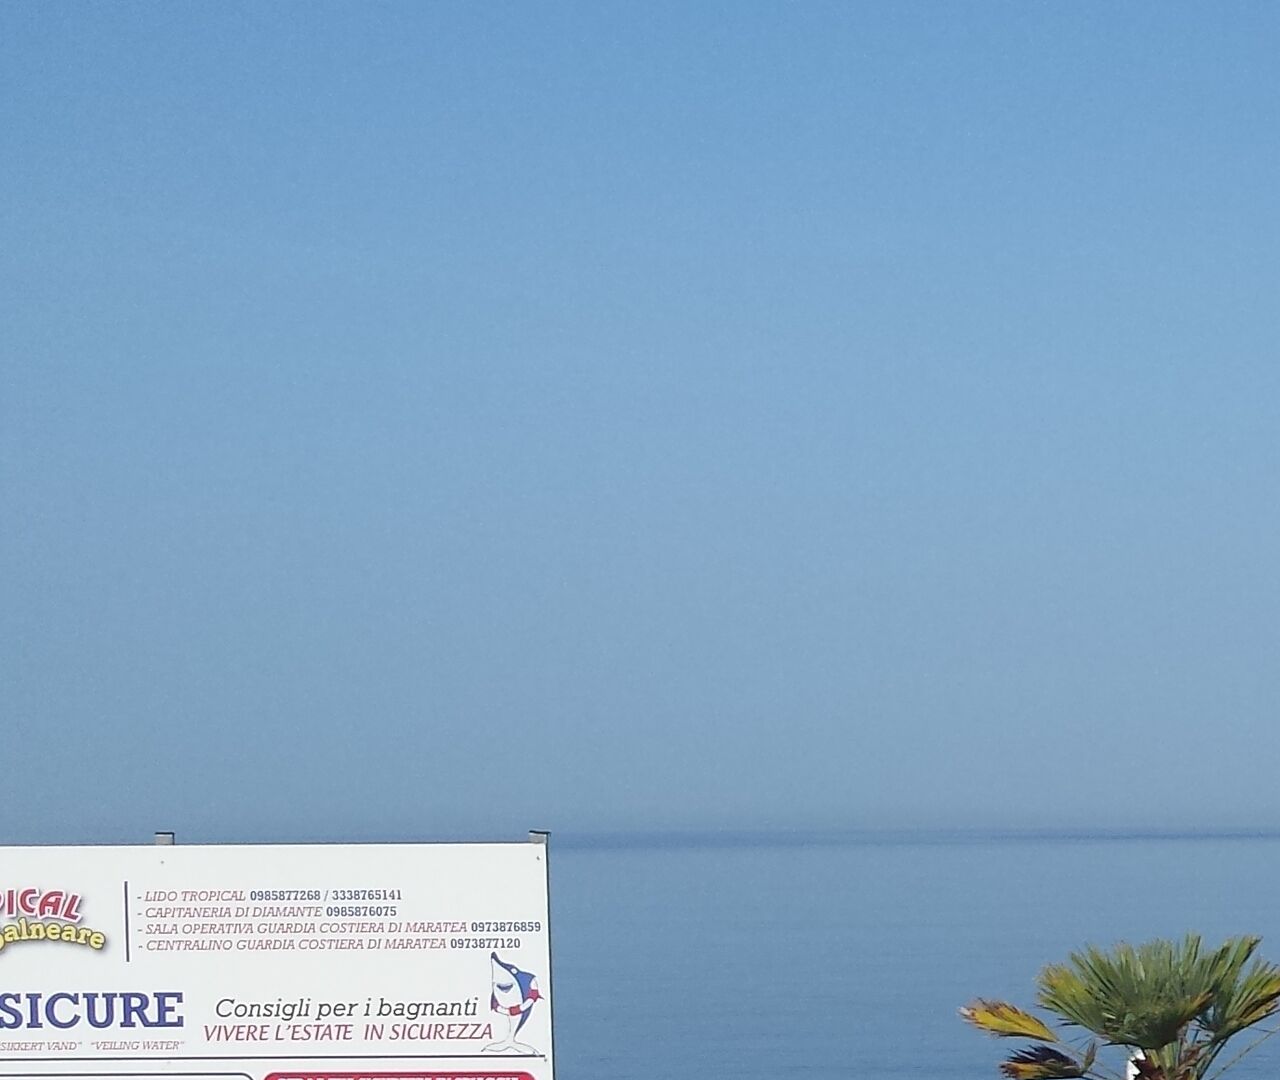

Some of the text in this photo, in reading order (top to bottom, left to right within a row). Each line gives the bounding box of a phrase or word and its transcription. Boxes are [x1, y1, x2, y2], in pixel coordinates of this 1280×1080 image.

[144, 891, 178, 902] LIDO
[181, 890, 246, 902] TROPICAL
[250, 890, 321, 901] 0985877268
[331, 889, 402, 901] 3338765141
[0, 888, 80, 922] ICAL
[145, 906, 397, 918] CAPITANERIA DI DIAMANTE 0985876075
[0, 918, 106, 951] alneare
[145, 921, 541, 935] SALA OPERATIVA GUARDIA COSTIERA DI MARATEA 0973876859
[146, 938, 521, 951] CENTRALINO GUARDIA COSTIERA DI MARATEA 0973877120
[0, 991, 184, 1029] SICURE
[215, 997, 479, 1021] Consigli per i bagnanti
[203, 1023, 494, 1041] VIVERE L'ESTATE IN SICUREZZA
